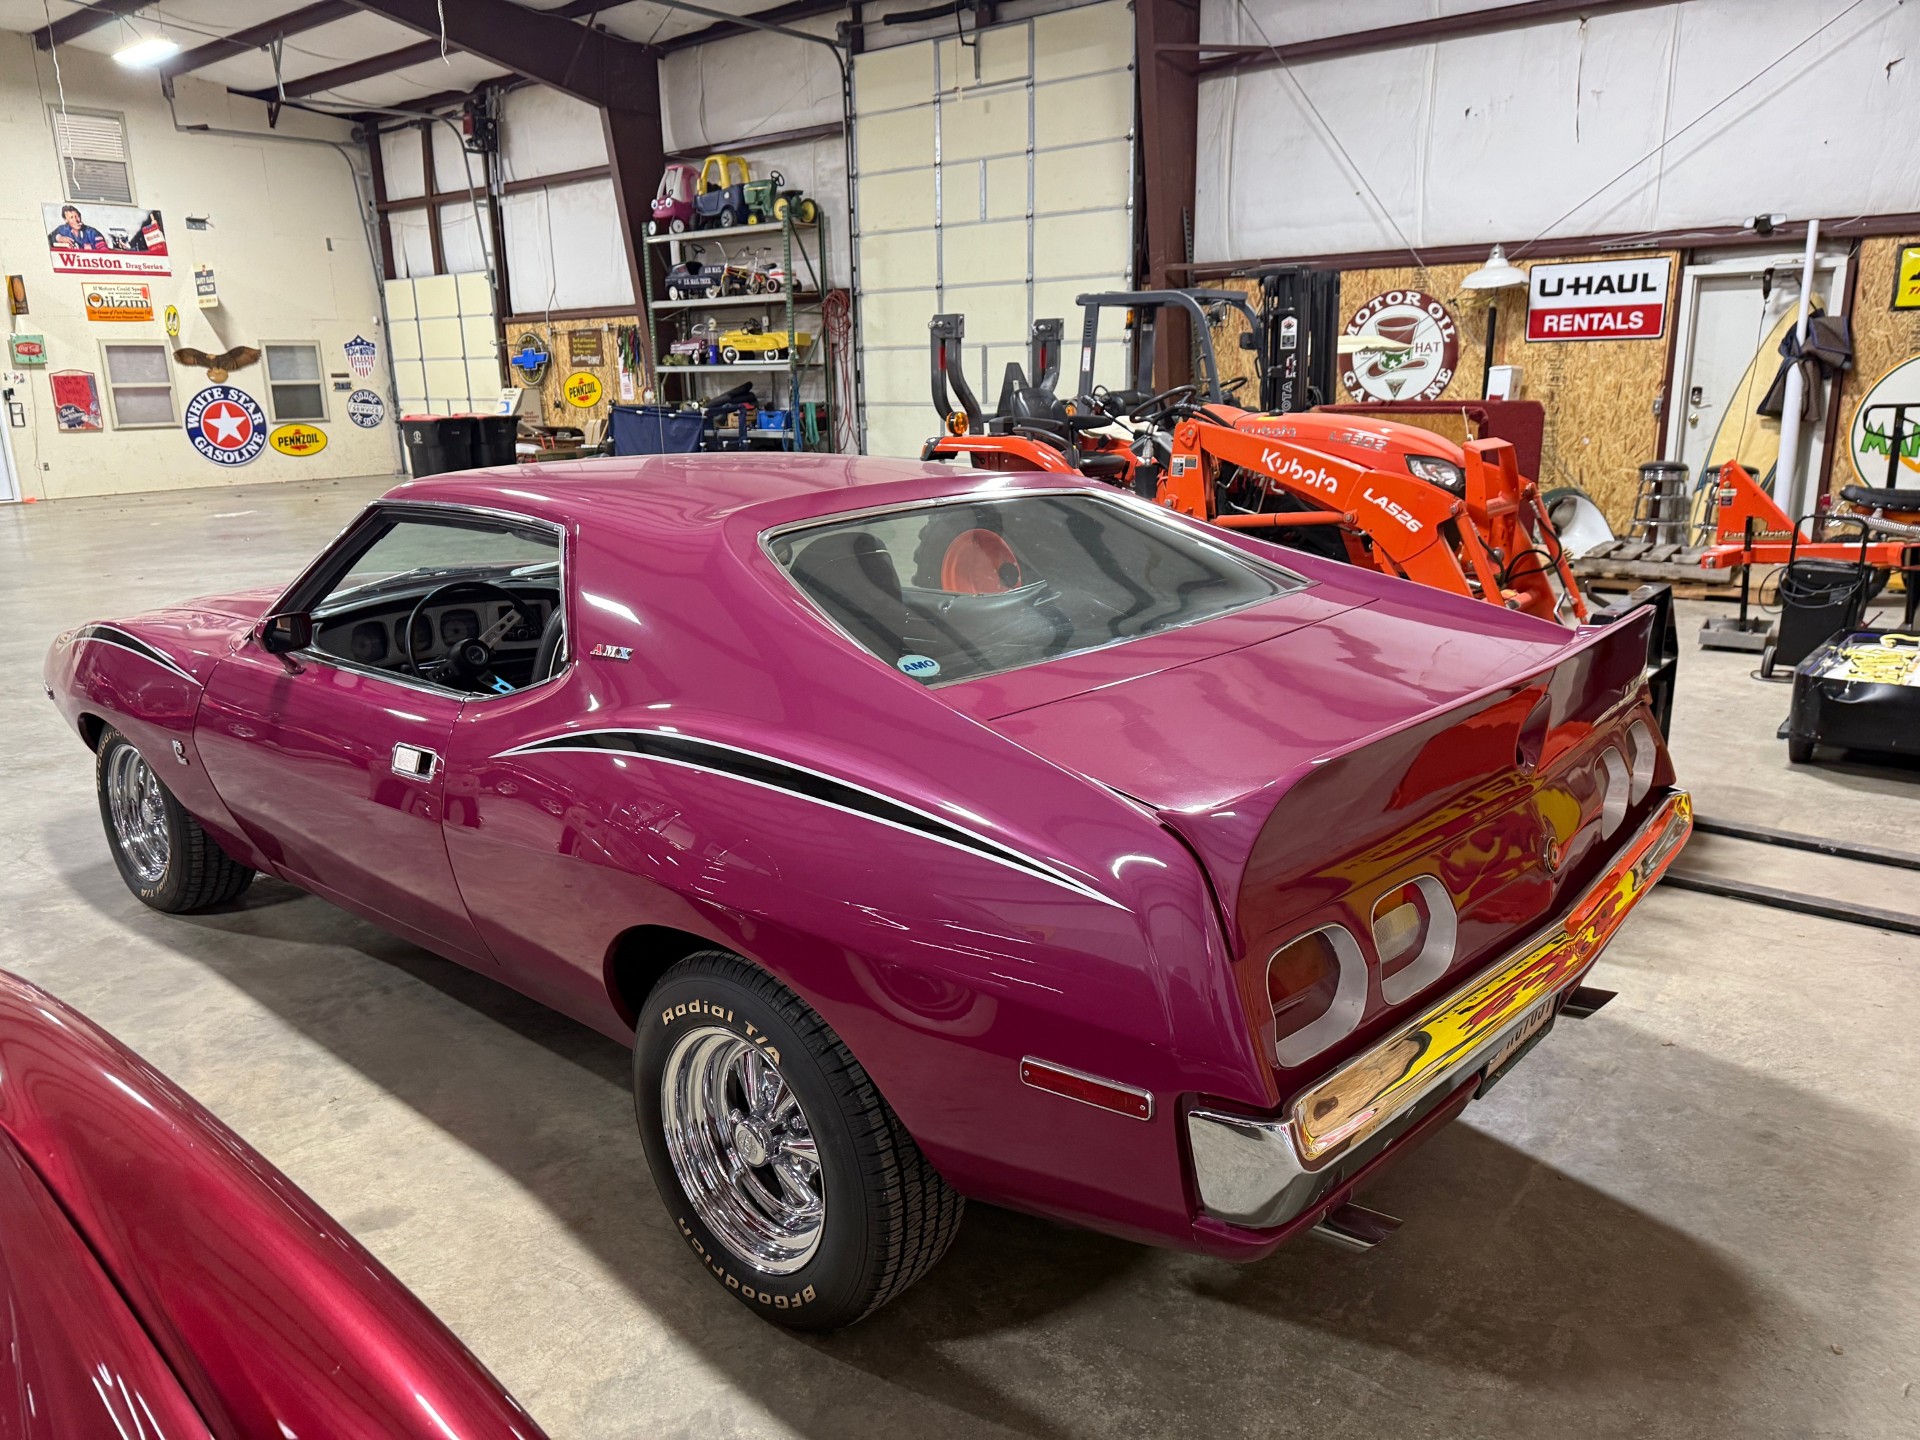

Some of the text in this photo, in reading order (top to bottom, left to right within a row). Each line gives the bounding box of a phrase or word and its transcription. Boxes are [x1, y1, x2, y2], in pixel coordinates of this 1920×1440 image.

[58, 253, 122, 269] Winston
[125, 262, 142, 271] Drag
[1539, 273, 1657, 297] U-HAUL
[1346, 291, 1456, 343] MOTOR OIL
[1543, 311, 1644, 332] RENTALS
[1415, 342, 1440, 353] HAT
[353, 391, 377, 405] DODGE
[569, 381, 597, 398] PENNZOIL
[187, 388, 264, 429] WHITE STAR
[194, 432, 265, 463] GASOLINE
[278, 433, 319, 447] PENNZOIL
[1260, 448, 1338, 494] Kubota
[1363, 487, 1423, 533] LA526
[589, 643, 635, 660] AMX
[903, 659, 936, 672] AMO
[661, 999, 781, 1066] Radial T/A
